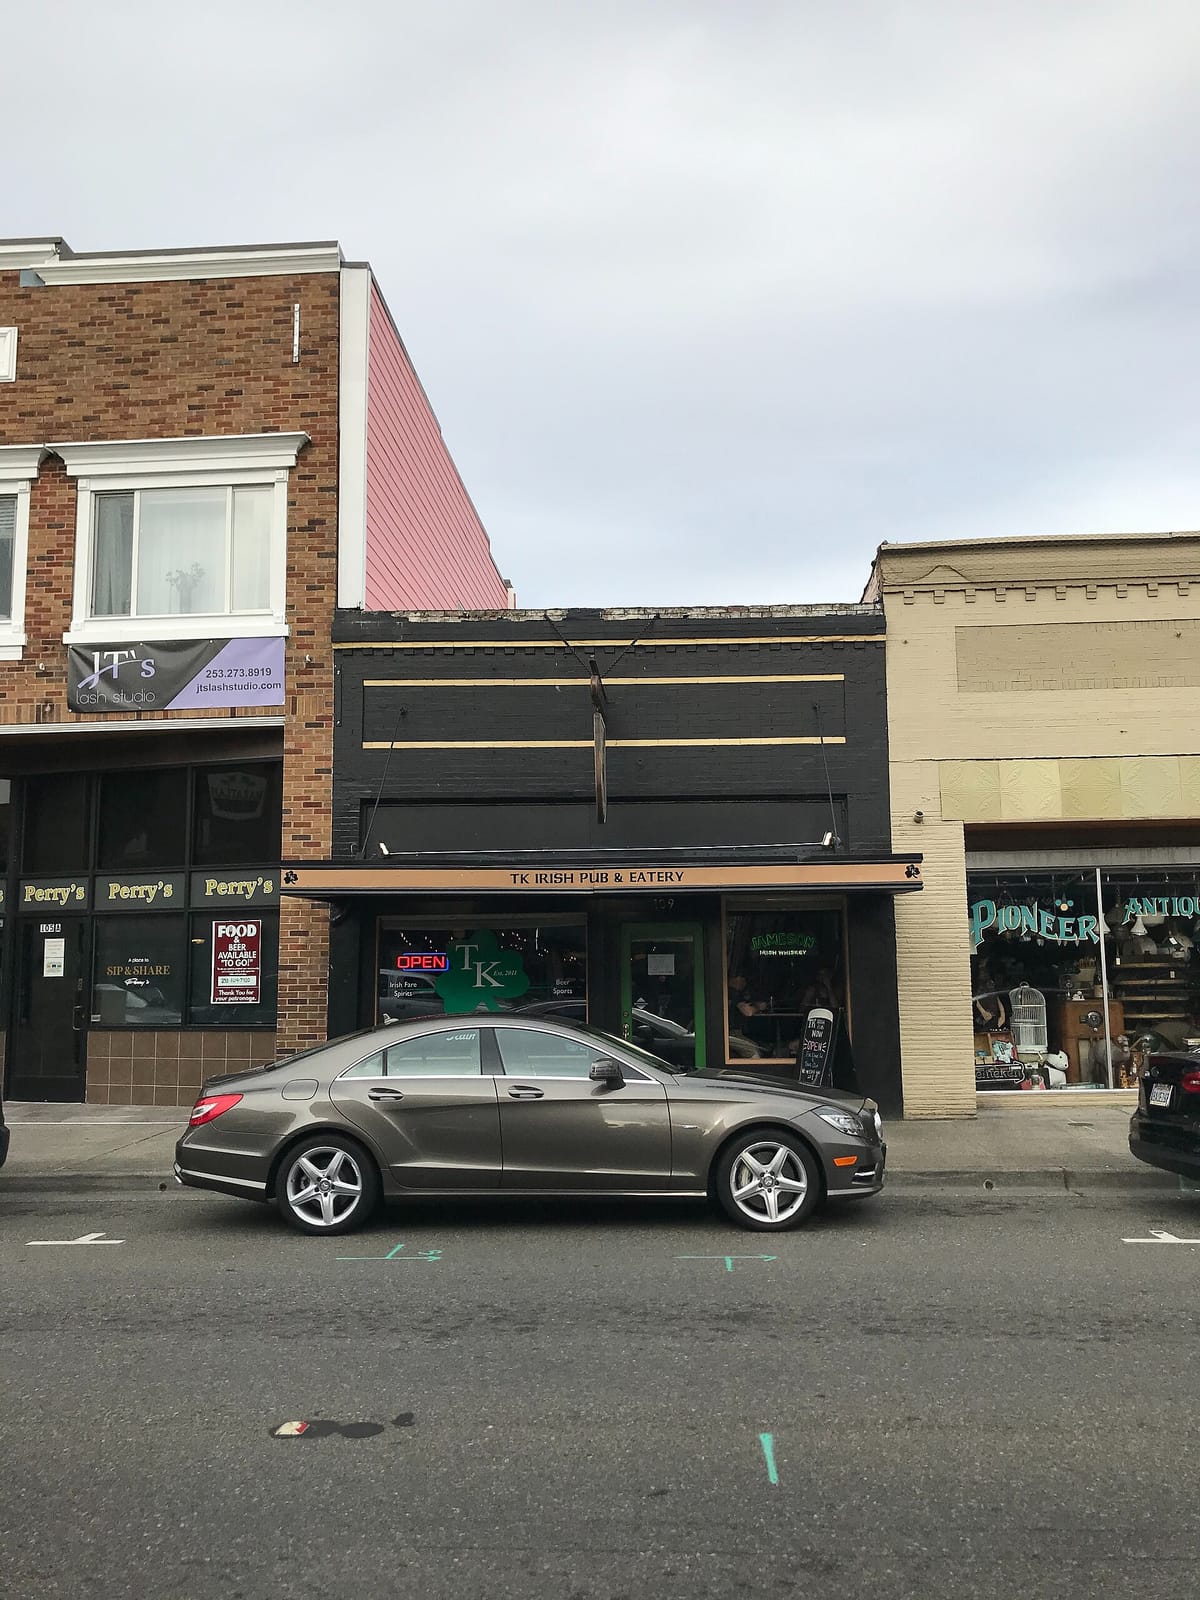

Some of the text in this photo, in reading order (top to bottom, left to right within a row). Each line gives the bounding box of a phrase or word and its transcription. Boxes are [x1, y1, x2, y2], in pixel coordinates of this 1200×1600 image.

[205, 668, 272, 678] 253.273.8919
[196, 682, 281, 694] jtslashstudio.com
[76, 689, 156, 705] lash studio
[510, 871, 685, 884] TK IRISH PUB & EATERY
[24, 883, 85, 906] Perry's
[108, 880, 173, 903] Perry's
[204, 877, 273, 900] Perry's
[217, 924, 257, 938] FOOD
[228, 943, 246, 951] BEER
[217, 951, 257, 959] AVAILABLE
[397, 955, 446, 969] OPEN
[106, 965, 171, 976] SIP & SHARE
[807, 1040, 823, 1051] OPEN
[976, 1068, 1022, 1080] eineken
